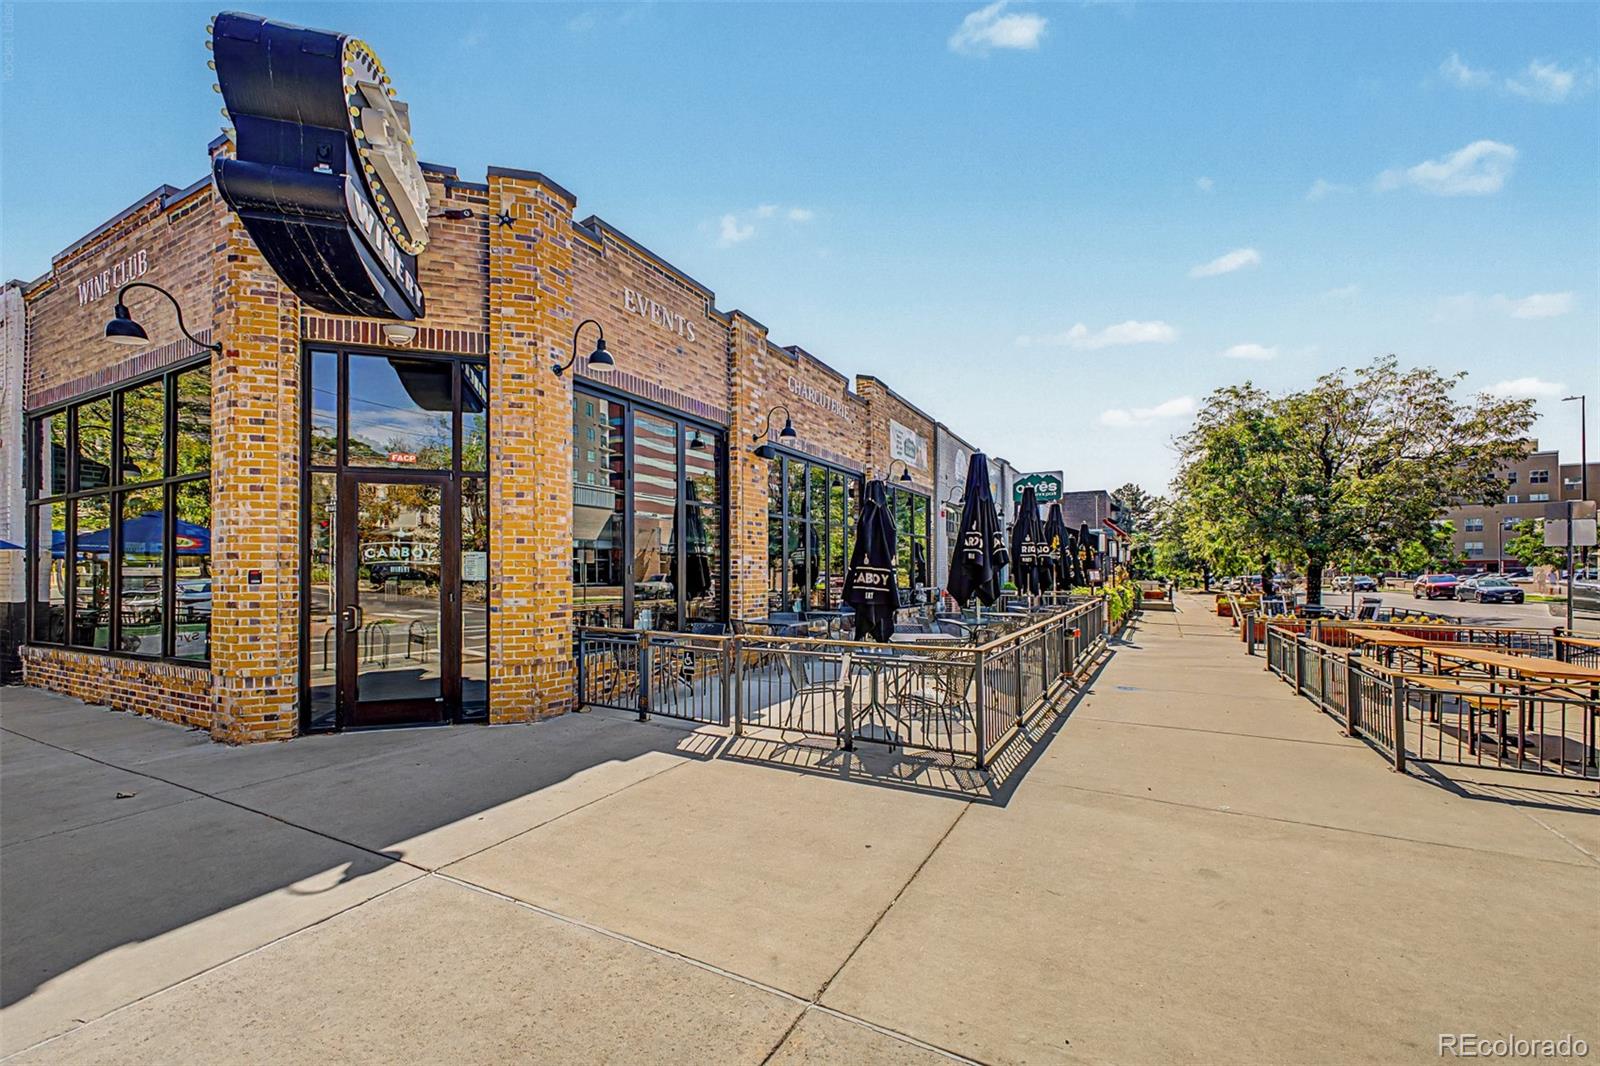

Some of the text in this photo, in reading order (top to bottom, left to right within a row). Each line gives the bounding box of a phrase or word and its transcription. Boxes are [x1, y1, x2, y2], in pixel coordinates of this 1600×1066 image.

[354, 190, 422, 307] WINERY
[78, 249, 148, 307] WINE CLUB
[623, 286, 696, 342] EVENTS
[788, 375, 850, 420] CHARCUTERIE
